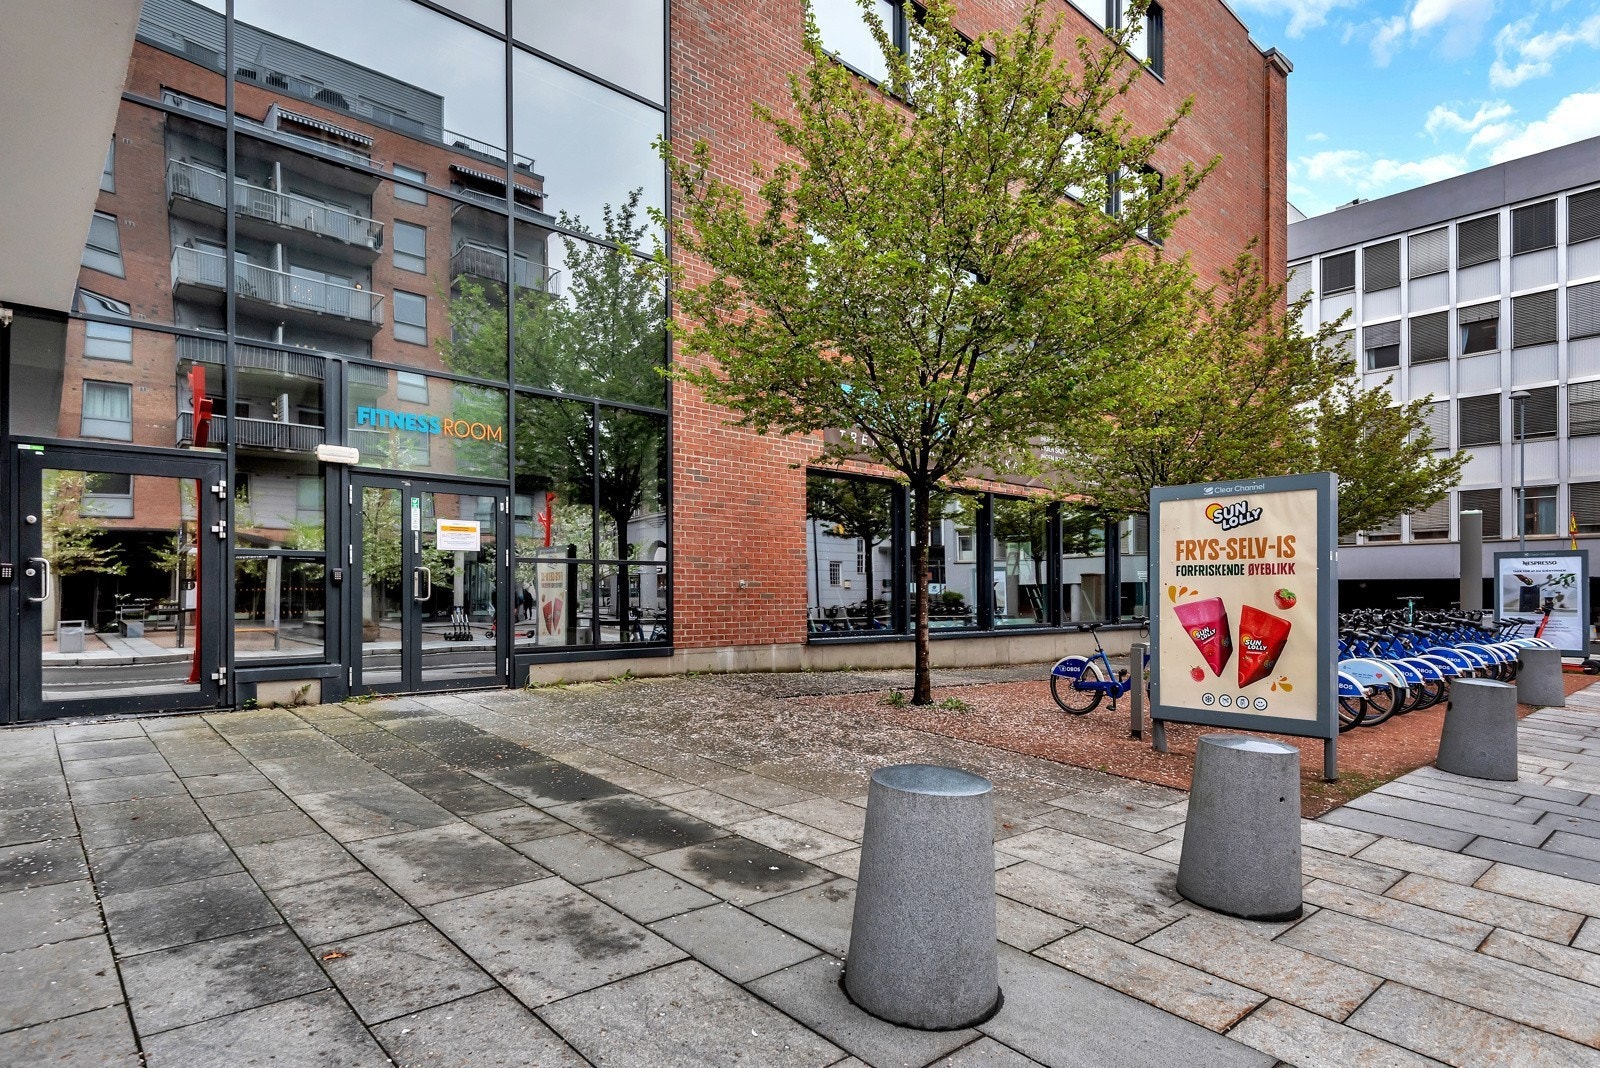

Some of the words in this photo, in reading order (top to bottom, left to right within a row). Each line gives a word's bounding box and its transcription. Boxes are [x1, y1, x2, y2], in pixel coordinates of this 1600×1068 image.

[357, 406, 441, 435] FITNESS
[444, 418, 502, 443] ROOM
[1214, 486, 1233, 494] Clear
[1234, 483, 1265, 492] Channel
[1213, 501, 1247, 523] SUN
[1222, 508, 1261, 530] LOLLY
[1175, 535, 1296, 562] FRYS-SELV-IS
[1176, 563, 1245, 577] FORFRISKENDE
[1247, 562, 1296, 577] ØYEBLIKK
[1196, 627, 1210, 639] SUN
[1200, 628, 1216, 640] LOLLY
